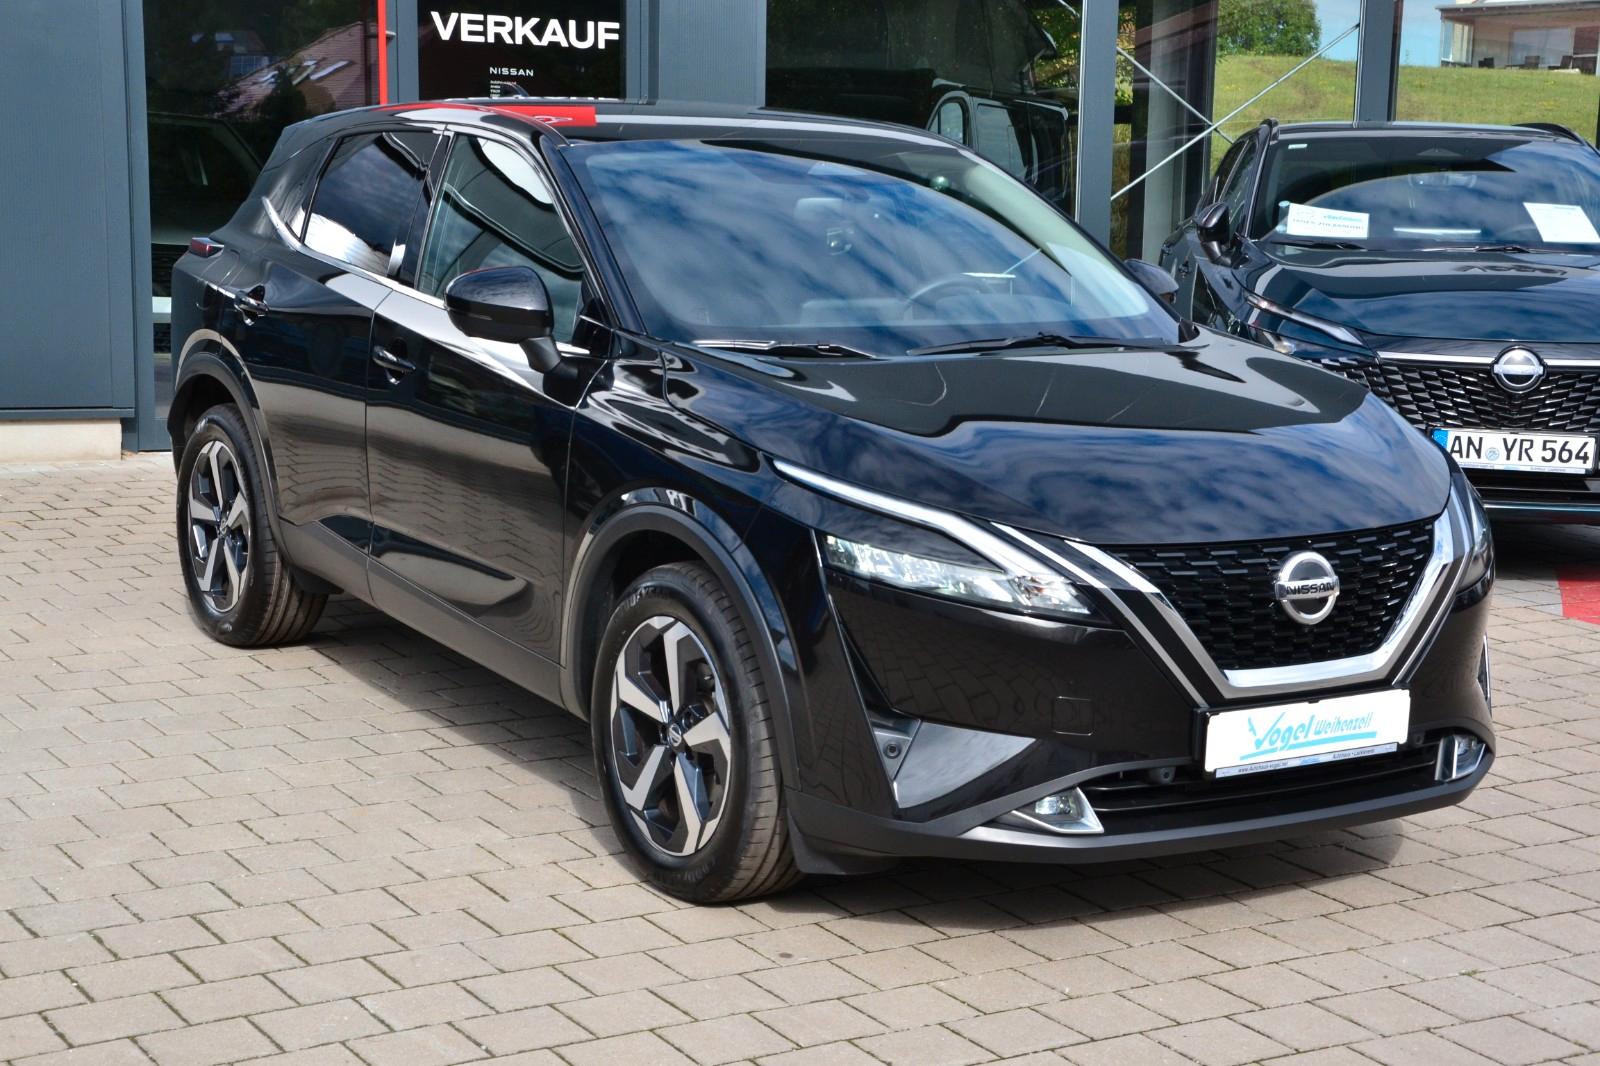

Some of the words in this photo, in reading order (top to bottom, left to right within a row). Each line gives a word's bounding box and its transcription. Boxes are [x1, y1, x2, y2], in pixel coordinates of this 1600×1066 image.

[430, 11, 620, 49] VERKAUF
[489, 66, 534, 77] NISSAN
[1450, 435, 1483, 459] AN
[1502, 437, 1534, 462] YR
[1541, 439, 1590, 464] 564
[1286, 582, 1335, 595] NISSAN
[1247, 711, 1315, 752] Vogel
